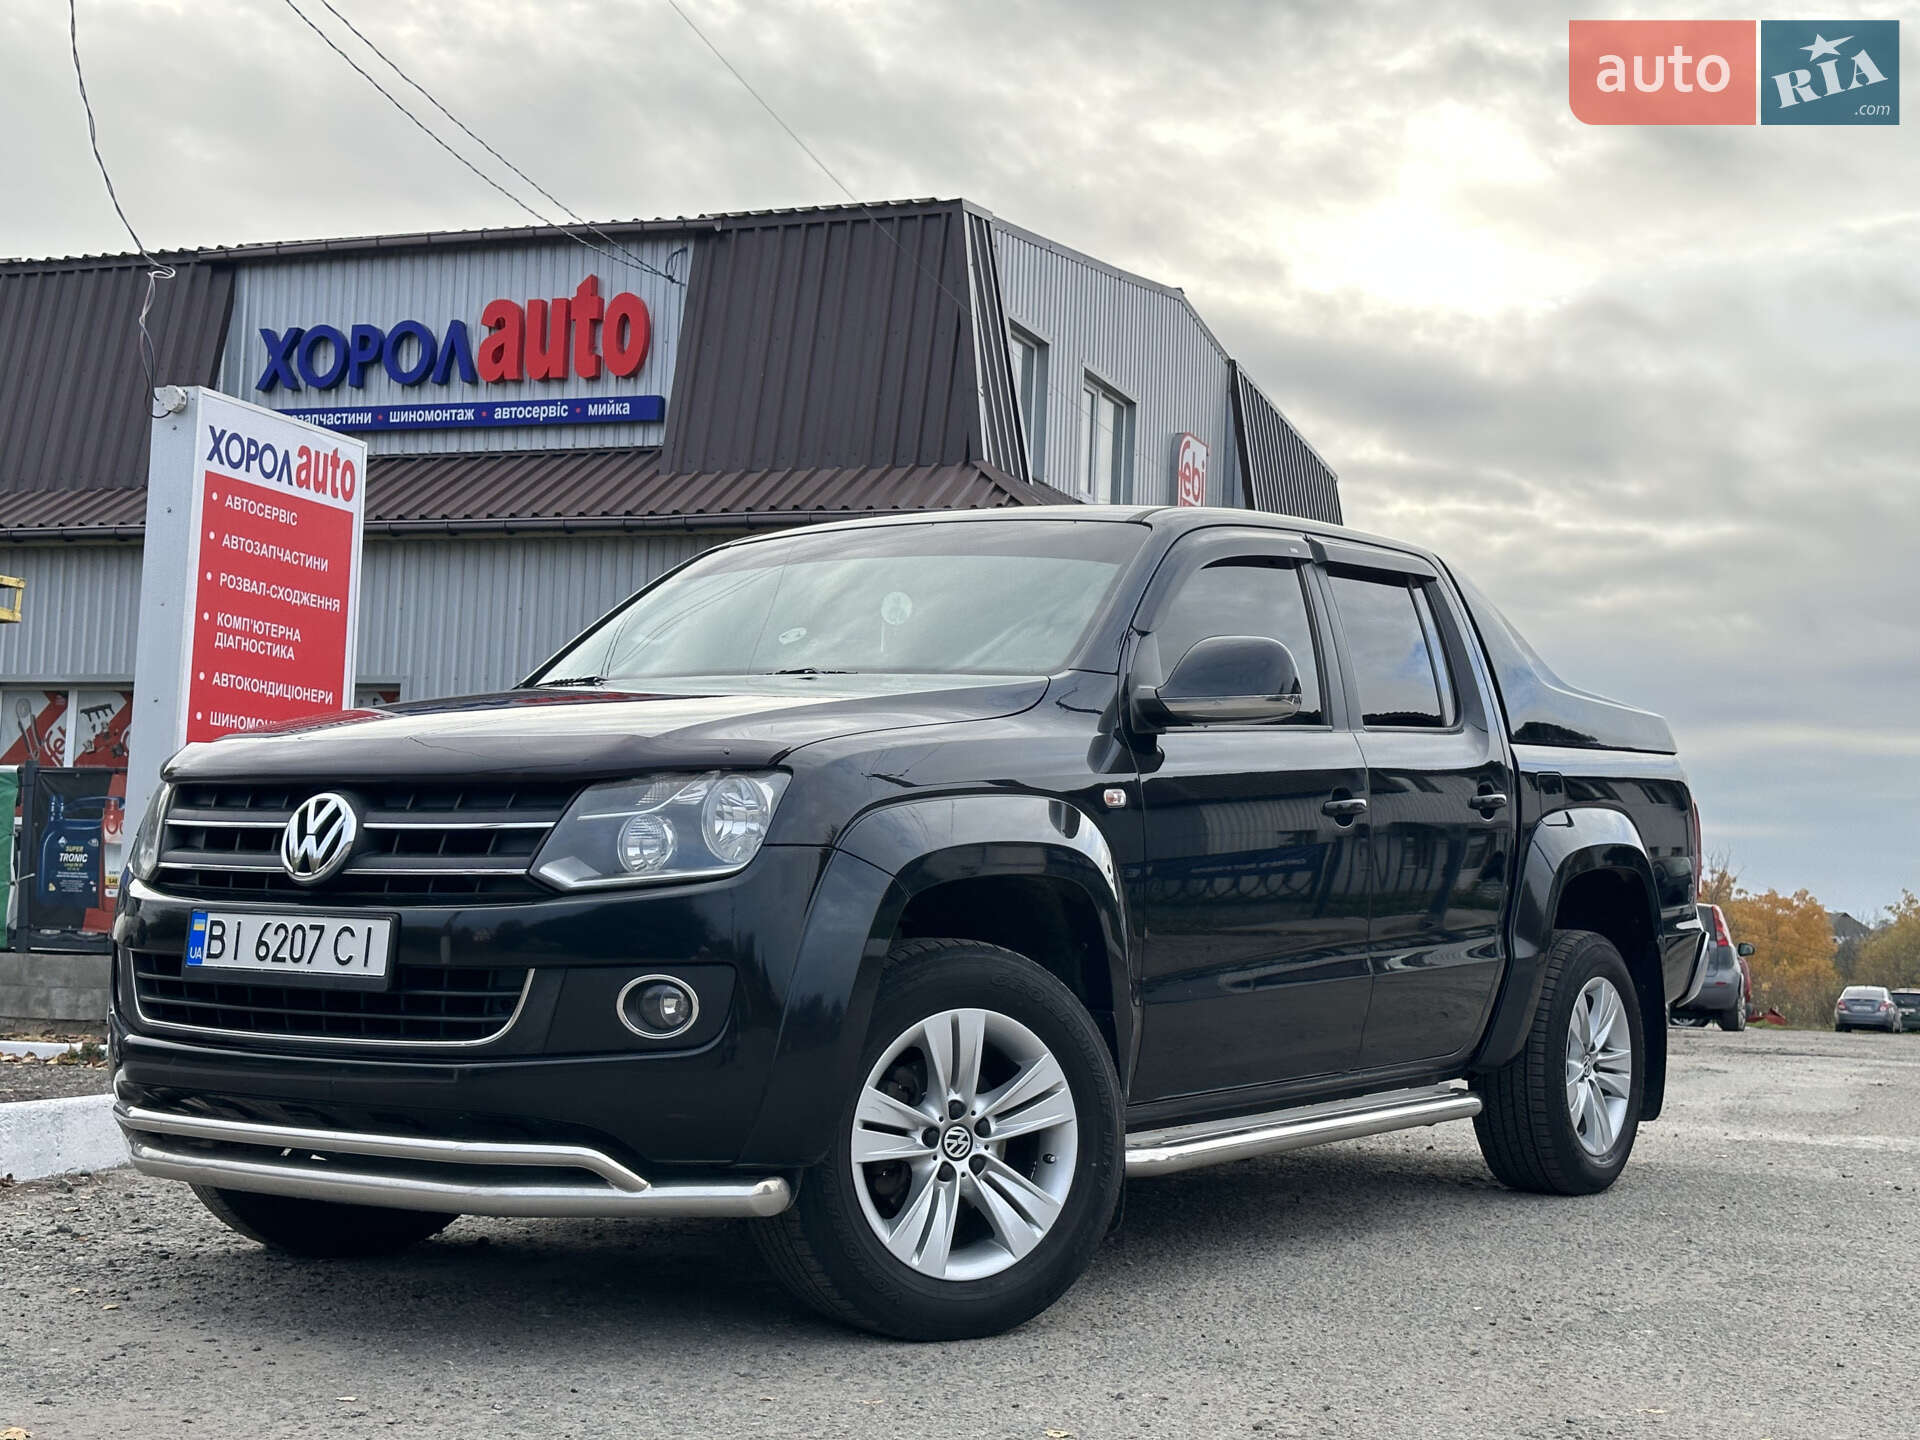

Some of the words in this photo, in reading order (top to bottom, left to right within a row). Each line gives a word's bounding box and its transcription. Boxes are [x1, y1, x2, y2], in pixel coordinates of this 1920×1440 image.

[389, 407, 475, 423] шиномонтаж
[494, 402, 569, 421] автосервіс
[588, 400, 631, 416] мийка
[224, 494, 299, 527] АВТОСЕРВІС
[222, 533, 329, 573] АВТОЗАПЧАСТИНИ
[219, 572, 341, 613] РОЗВАЛ-СХОДЖЕННЯ
[216, 612, 302, 643] КОМП'ЮТЕРНА
[214, 631, 296, 661] ДІАГНОСТИКА
[212, 671, 334, 705] АВТОКОНДИЦІОНЕРИ
[59, 853, 88, 863] TRONIC
[189, 946, 202, 959] UA
[206, 919, 242, 961] BI
[255, 921, 325, 965] 6207
[333, 925, 373, 968] CI
